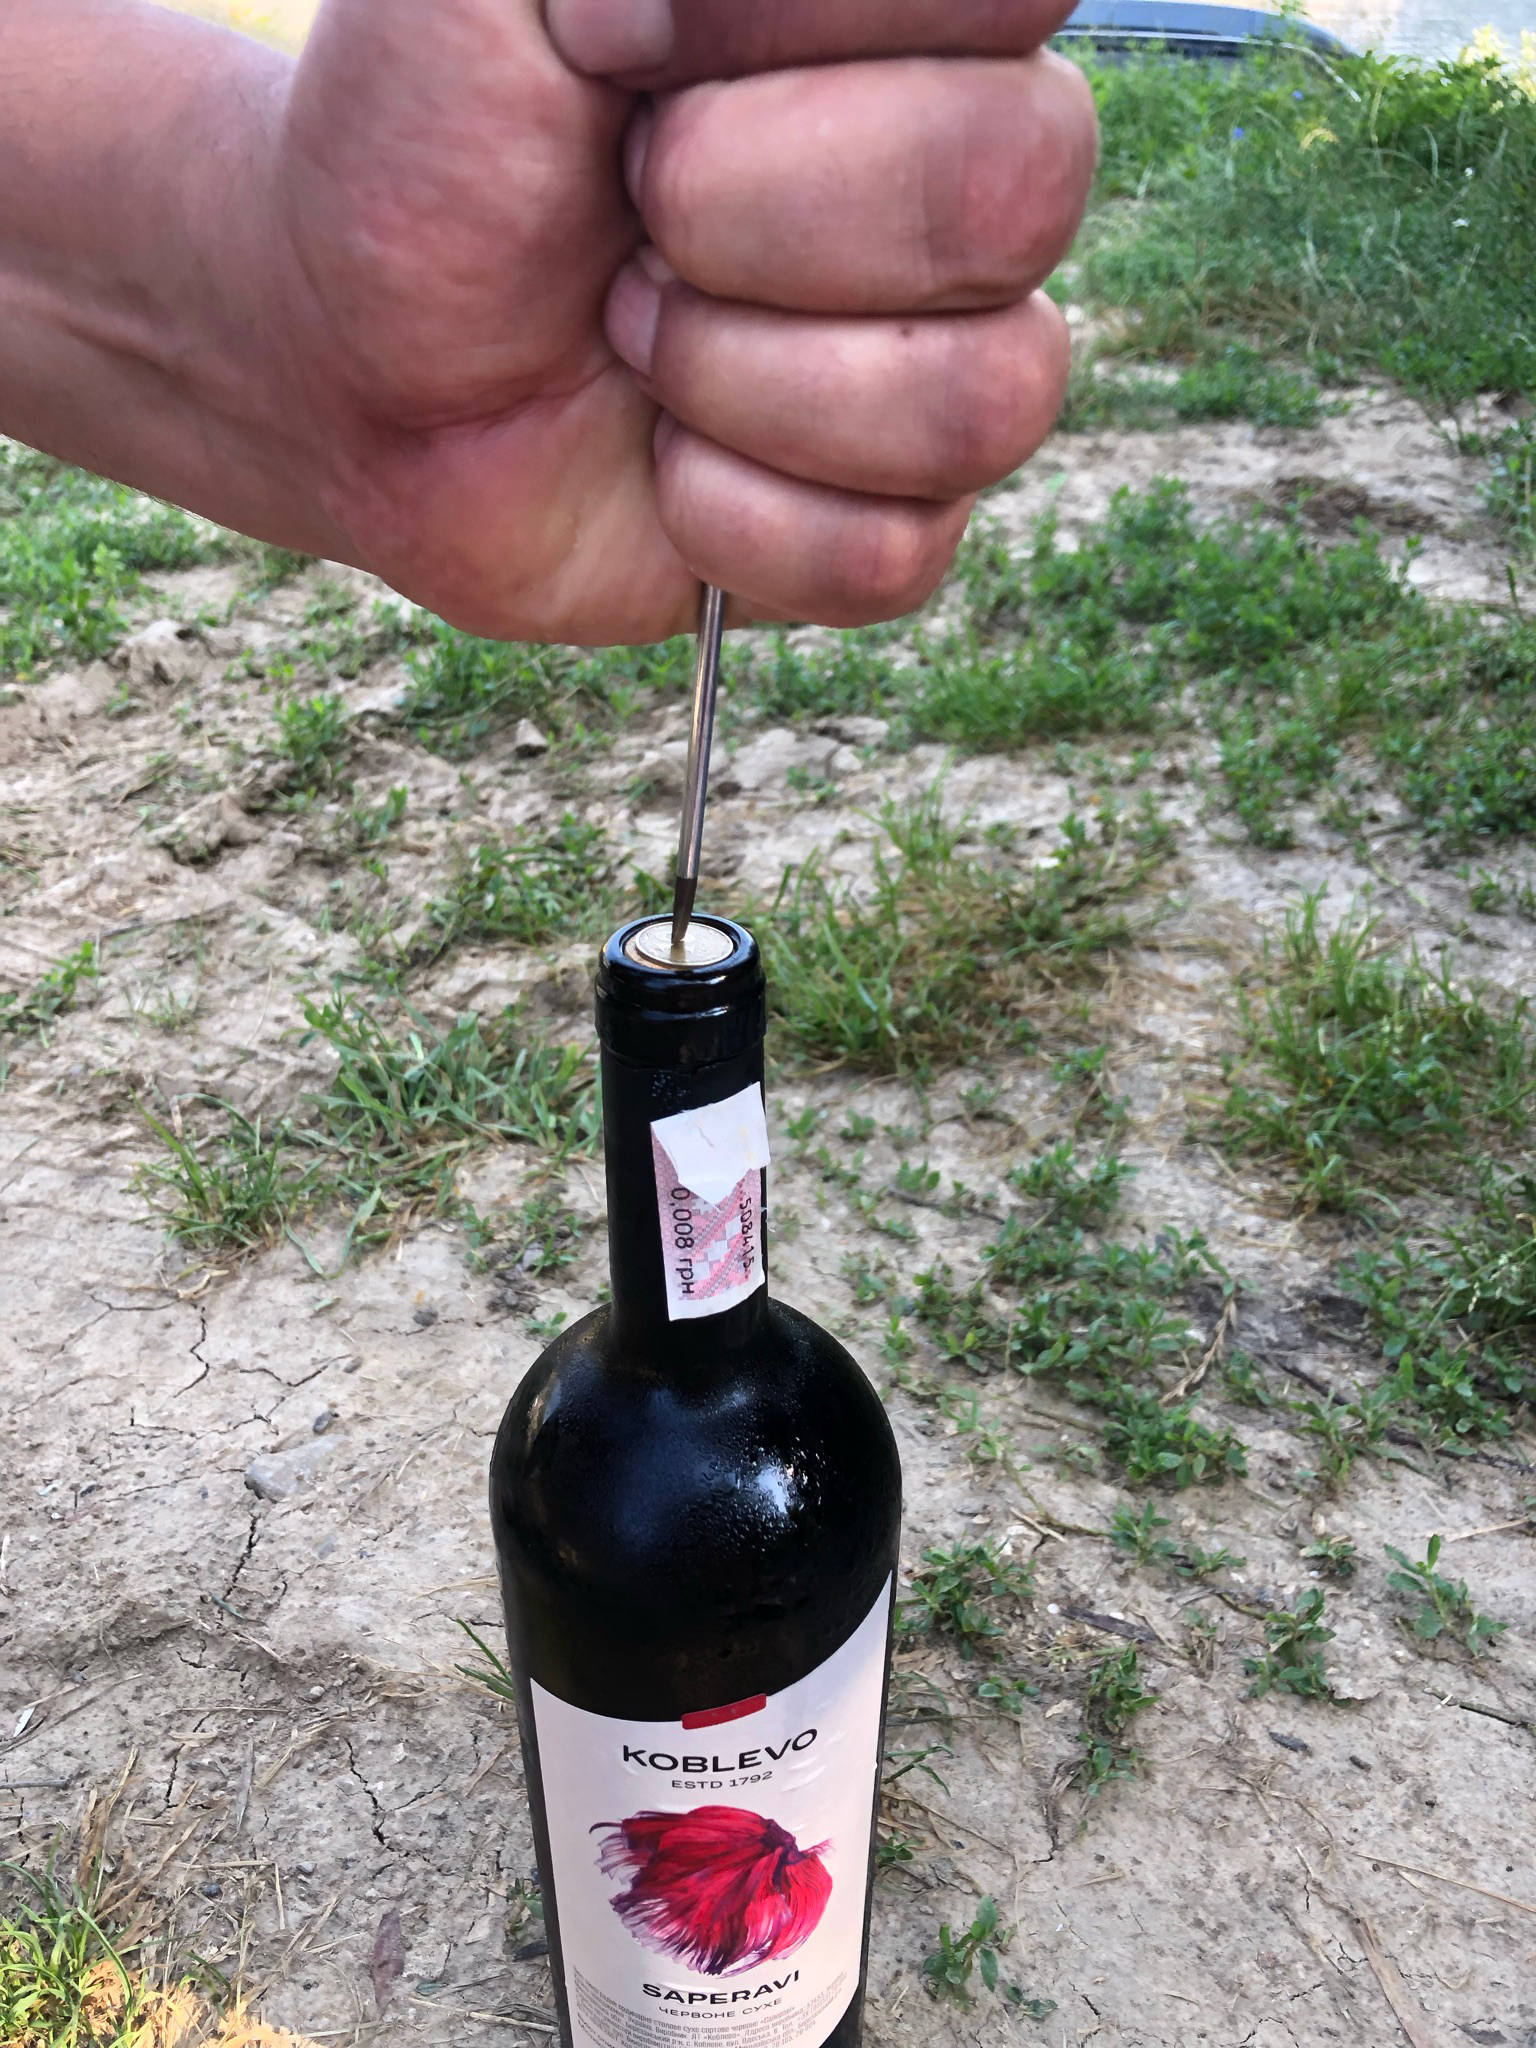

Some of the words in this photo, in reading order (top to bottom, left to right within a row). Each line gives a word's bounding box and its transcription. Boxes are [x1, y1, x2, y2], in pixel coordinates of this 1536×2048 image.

[671, 1187, 695, 1250] 0,008
[675, 1258, 695, 1295] грн
[623, 1728, 818, 1773] KOBLEVO
[671, 1779, 723, 1789] ESTD
[729, 1771, 773, 1787] 1792
[643, 1969, 800, 2005] SAPERAVI
[658, 2006, 736, 2019] ЧЕРВОНЕ
[742, 1998, 782, 2014] СУХЕ
